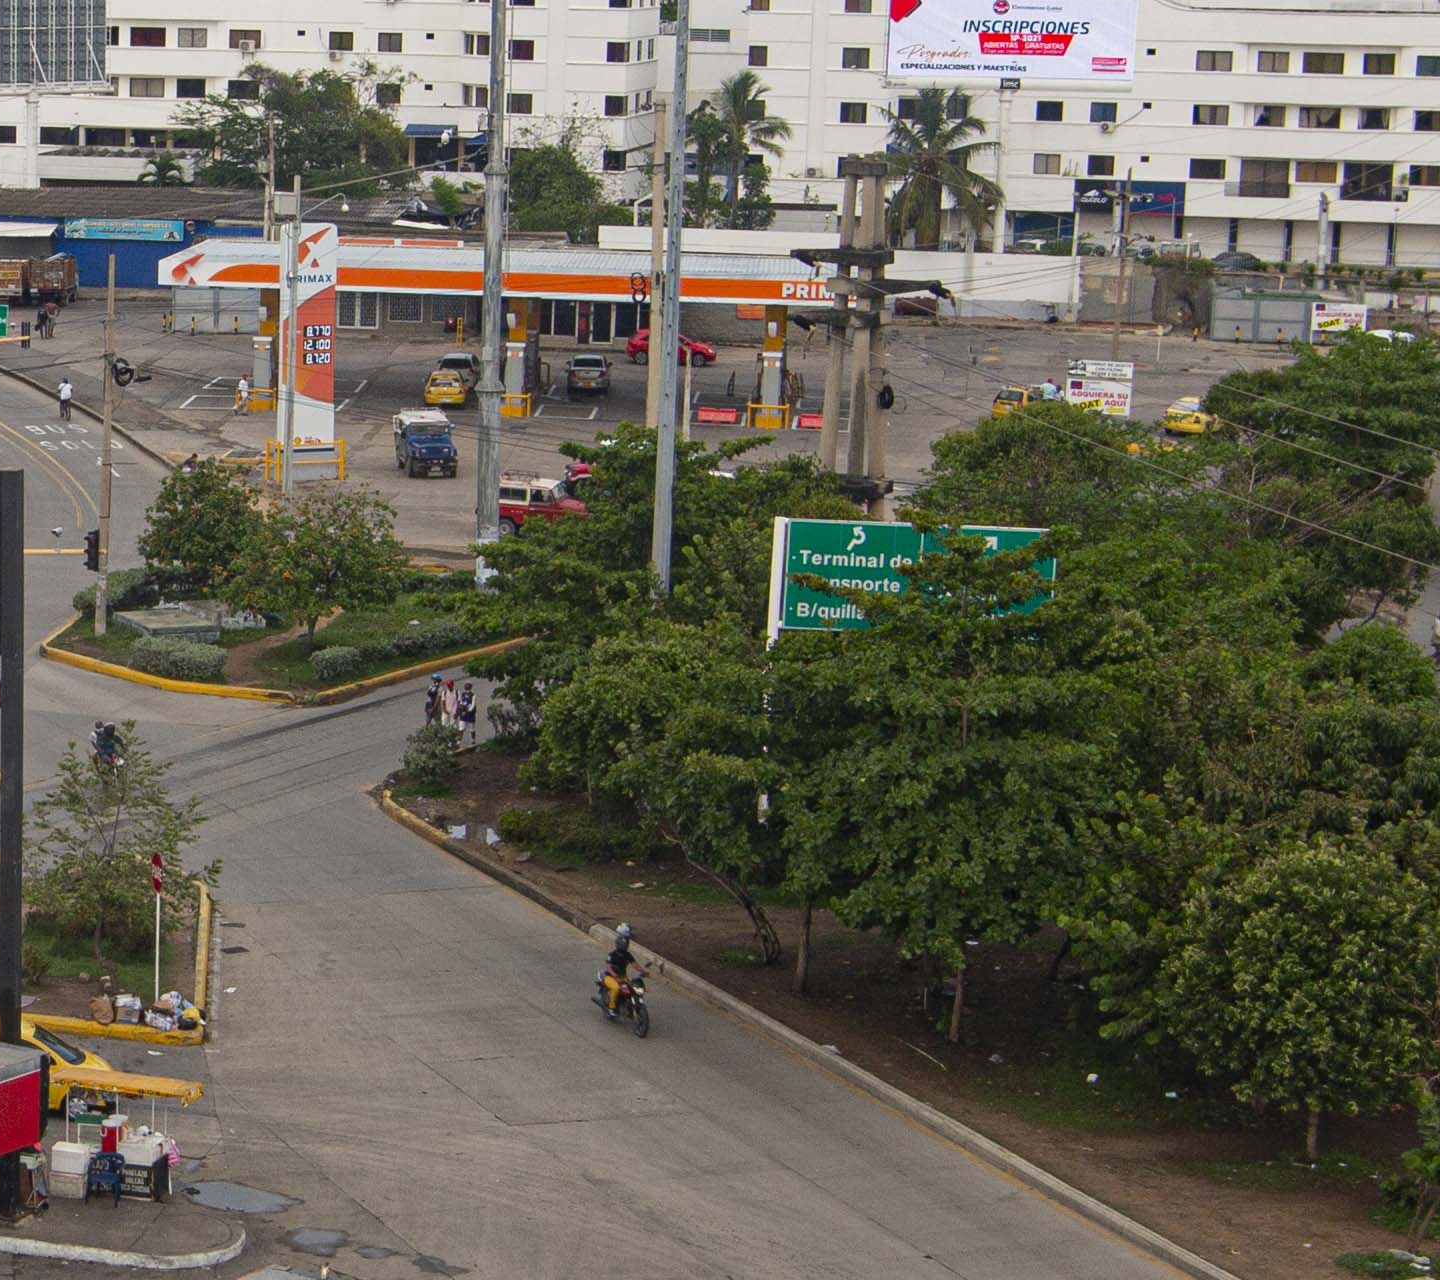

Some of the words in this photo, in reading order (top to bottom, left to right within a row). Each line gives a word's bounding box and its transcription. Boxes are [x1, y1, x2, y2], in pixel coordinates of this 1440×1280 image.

[963, 20, 1090, 35] INSCRIPCIONES
[900, 63, 976, 72] ESPECIALIZACIONES
[1071, 391, 1115, 399] ADQUIERA
[1117, 392, 1128, 400] SU
[800, 549, 884, 569] Terminal
[889, 552, 913, 568] de
[829, 576, 901, 594] nsporte
[796, 602, 865, 620] B/quilla
